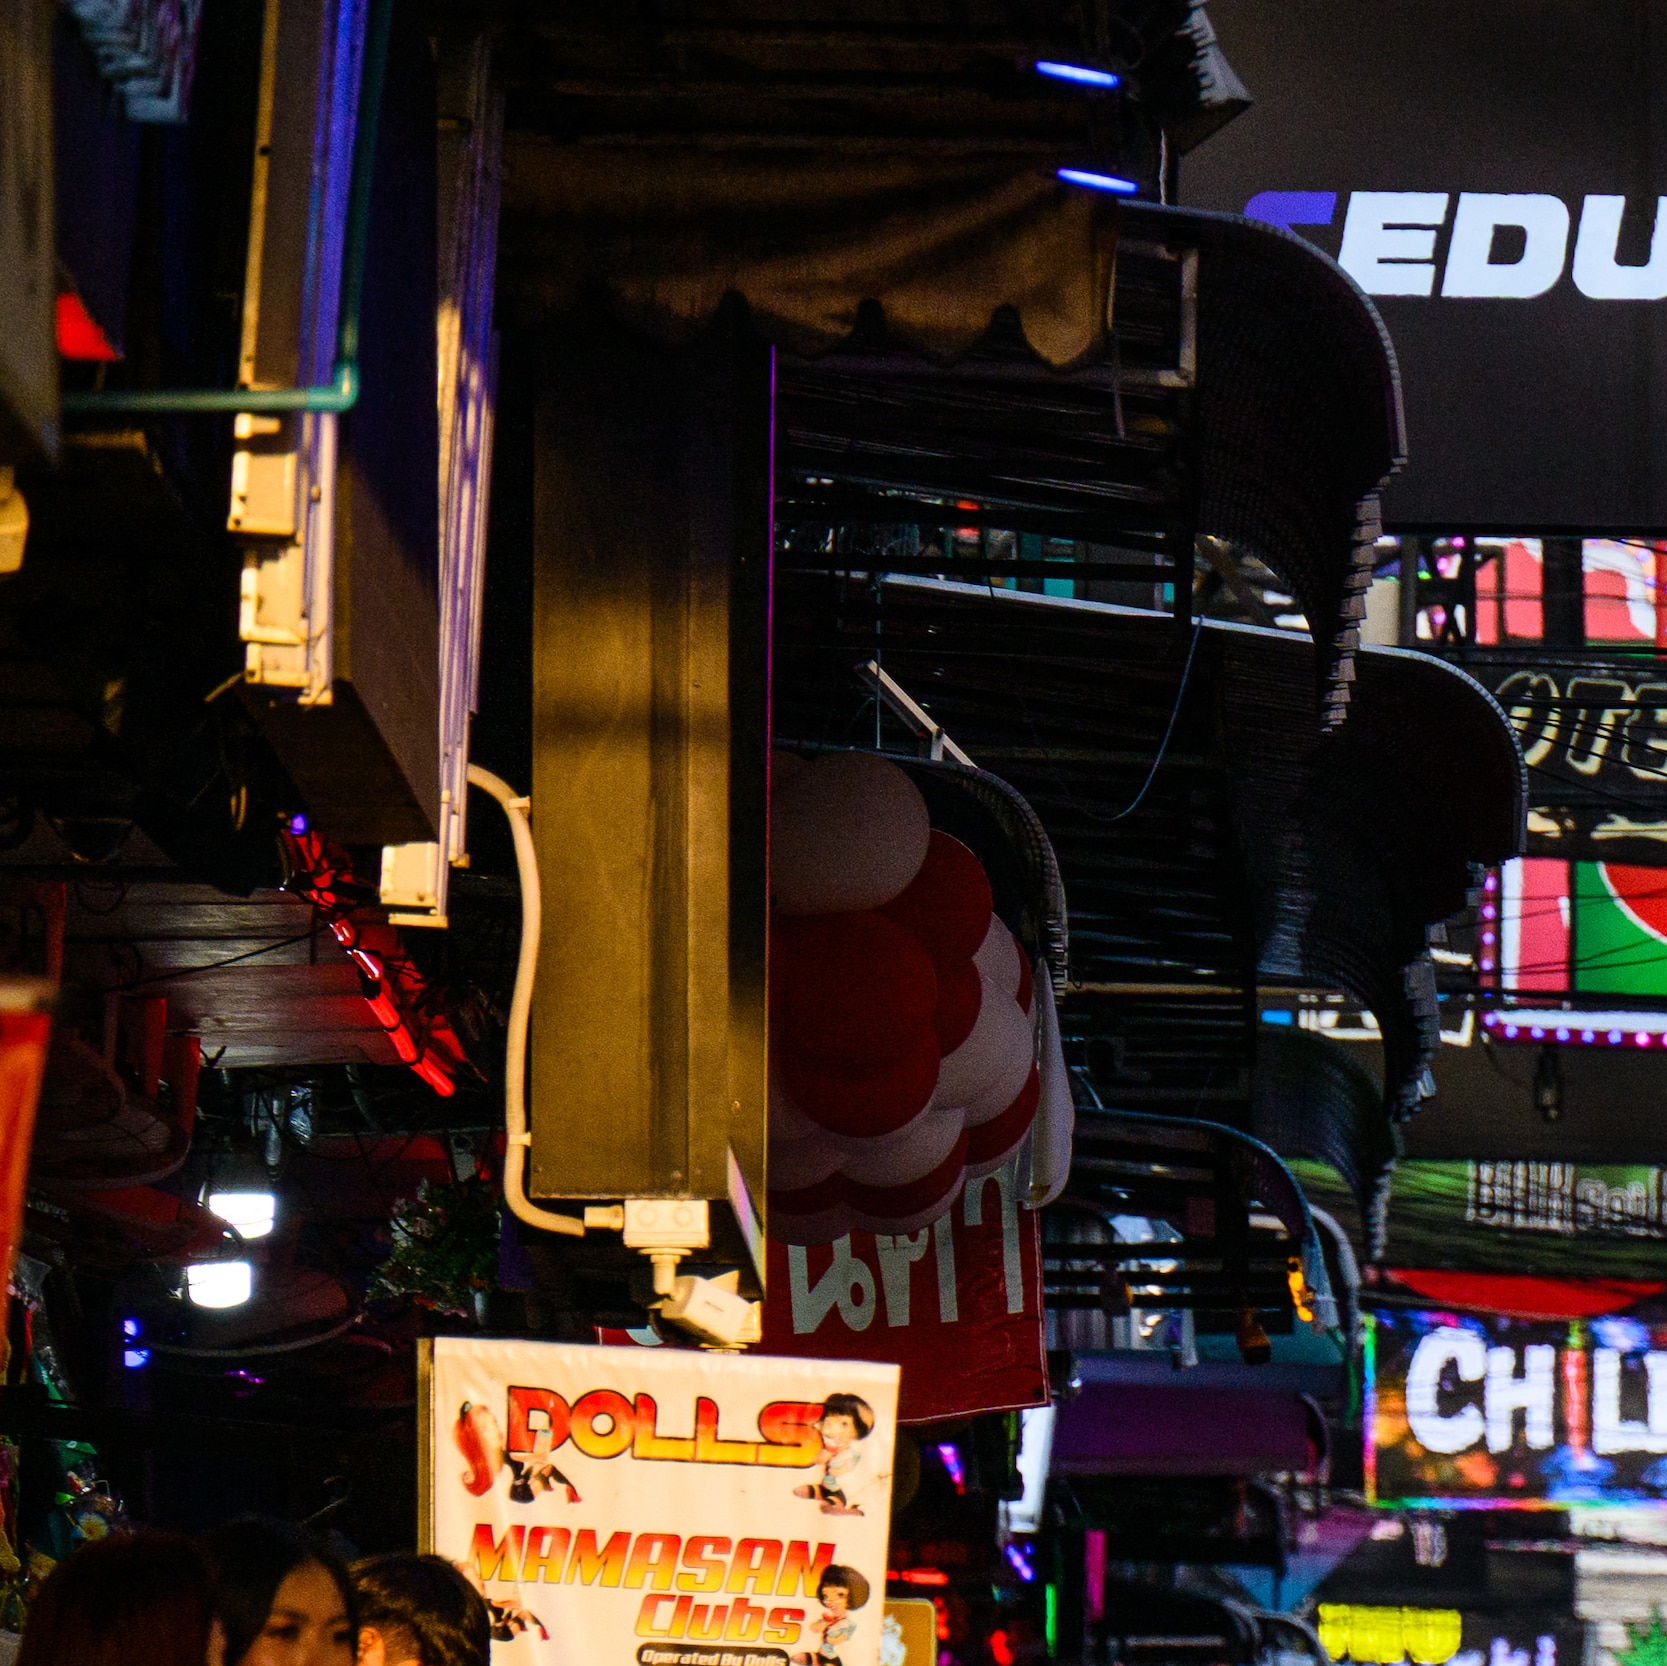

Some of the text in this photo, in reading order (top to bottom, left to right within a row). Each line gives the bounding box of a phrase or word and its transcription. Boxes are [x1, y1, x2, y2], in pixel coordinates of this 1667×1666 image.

[506, 1384, 825, 1470] DOLLS
[470, 1523, 837, 1599] MAMASAN
[634, 1593, 806, 1645] Clubs
[640, 1649, 721, 1666] Operated
